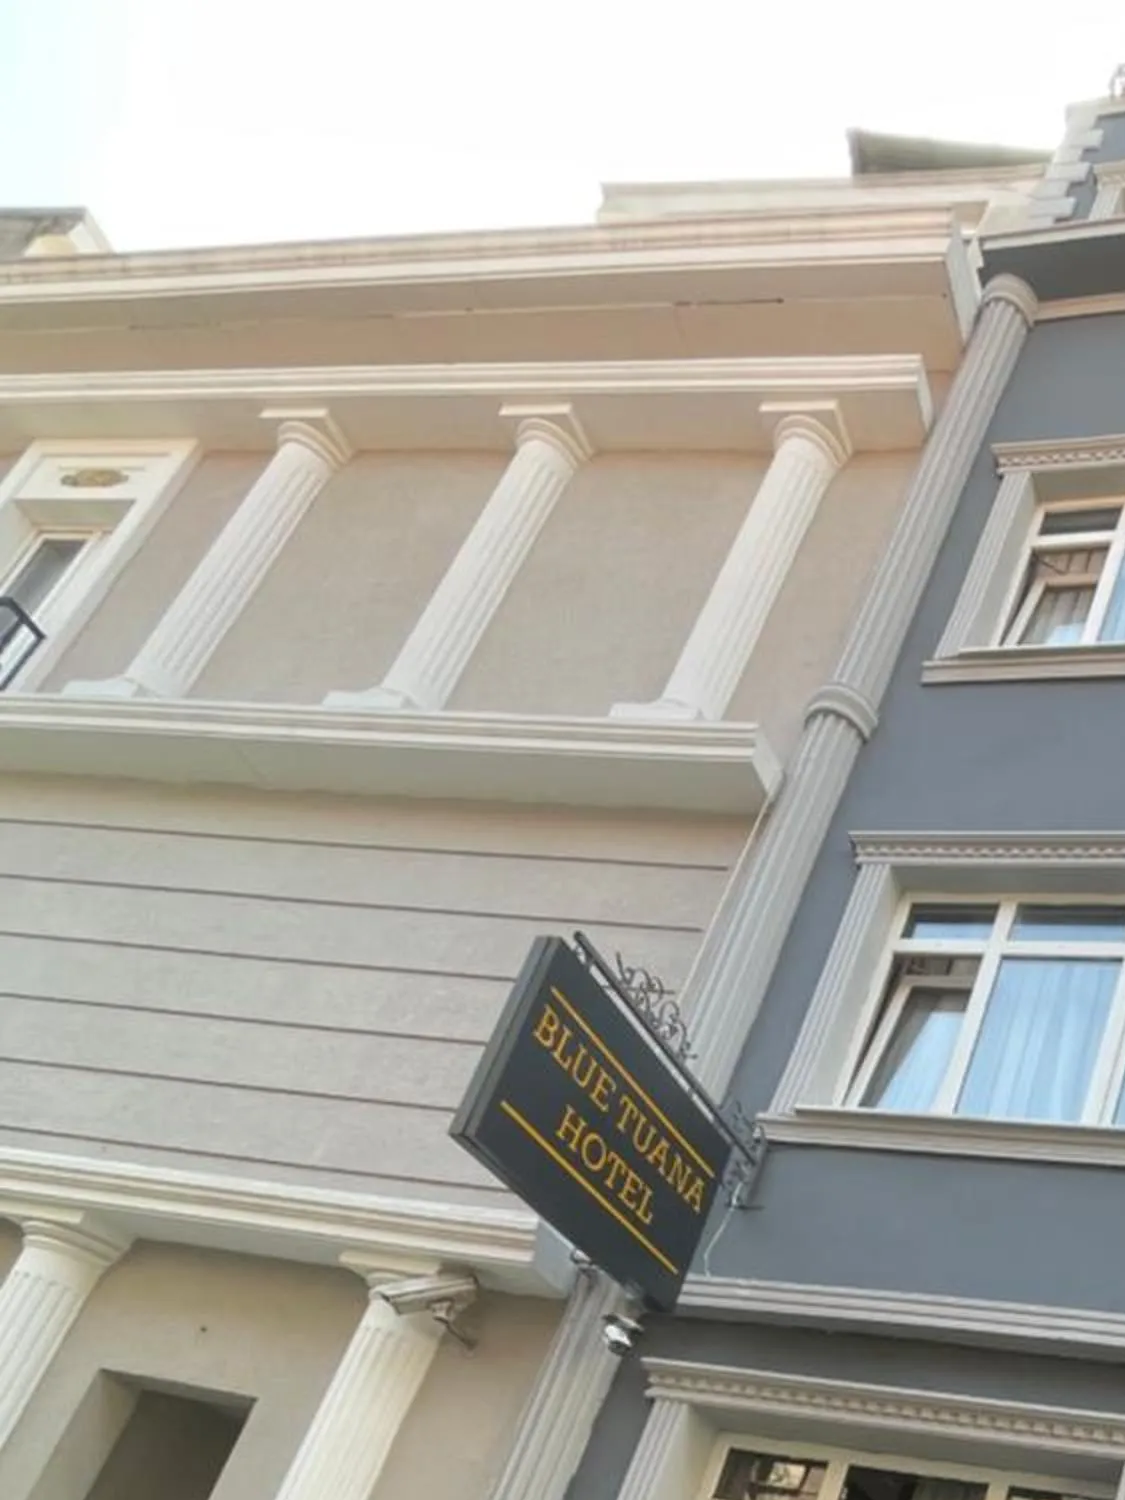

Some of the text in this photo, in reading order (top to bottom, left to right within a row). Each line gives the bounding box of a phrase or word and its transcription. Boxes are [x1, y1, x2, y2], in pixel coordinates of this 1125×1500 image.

[532, 1005, 705, 1214] BLUE TUANA
[555, 1104, 654, 1225] HOTEL
